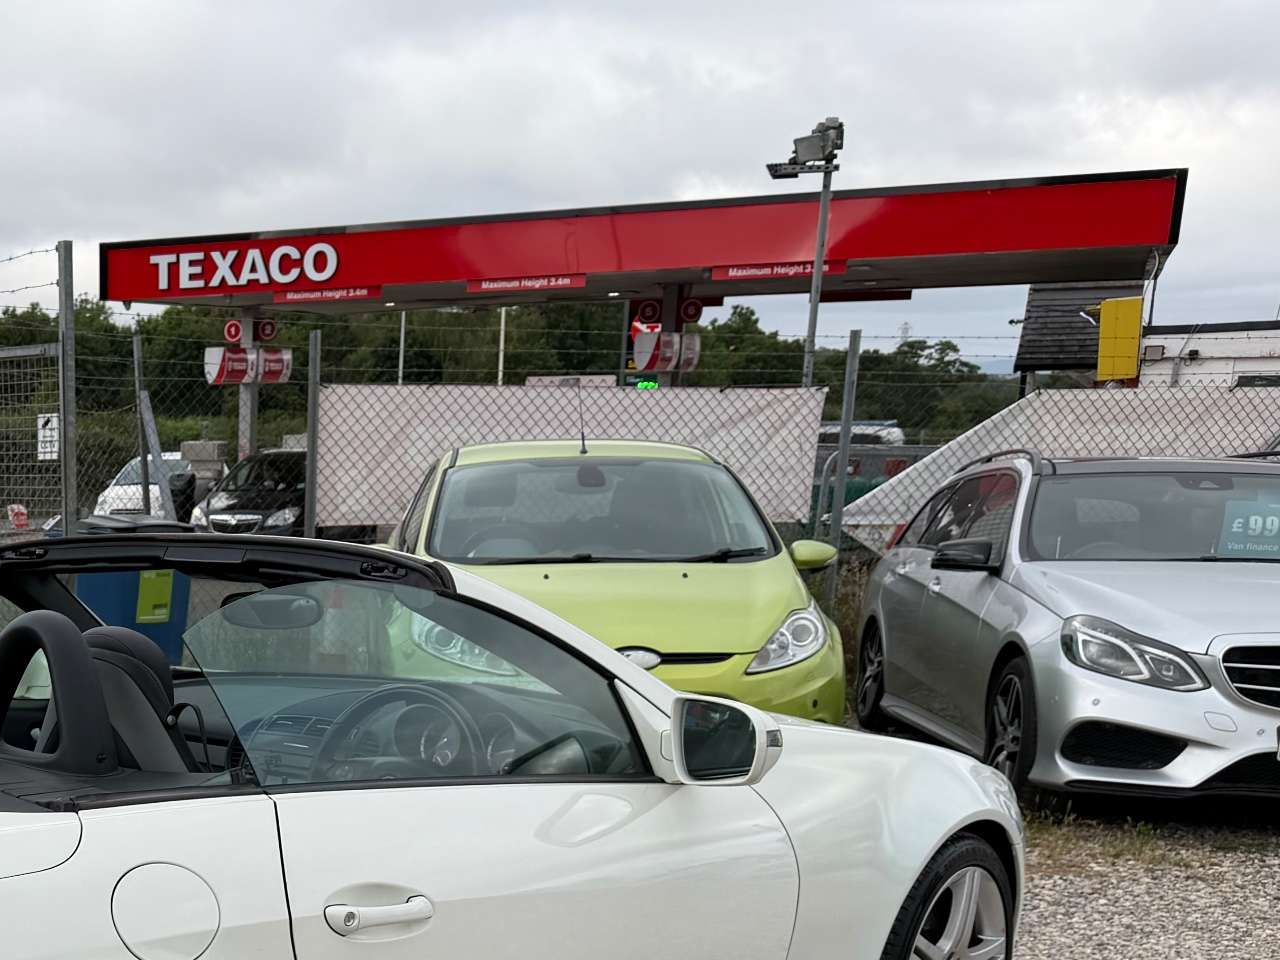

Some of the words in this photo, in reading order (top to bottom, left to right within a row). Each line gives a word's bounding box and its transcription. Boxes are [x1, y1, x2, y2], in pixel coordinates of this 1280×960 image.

[149, 242, 338, 290] TEXACO
[729, 267, 771, 277] Maximum
[773, 264, 803, 275] Height
[804, 263, 829, 273] 3.m
[481, 280, 519, 289] Maximum
[521, 278, 548, 288] Height
[550, 277, 571, 286] 3.4m
[286, 290, 322, 300] Maximum
[323, 288, 347, 299] Height
[348, 288, 368, 297] 3.4m
[1227, 542, 1244, 551] Van
[1246, 542, 1279, 551] finance
